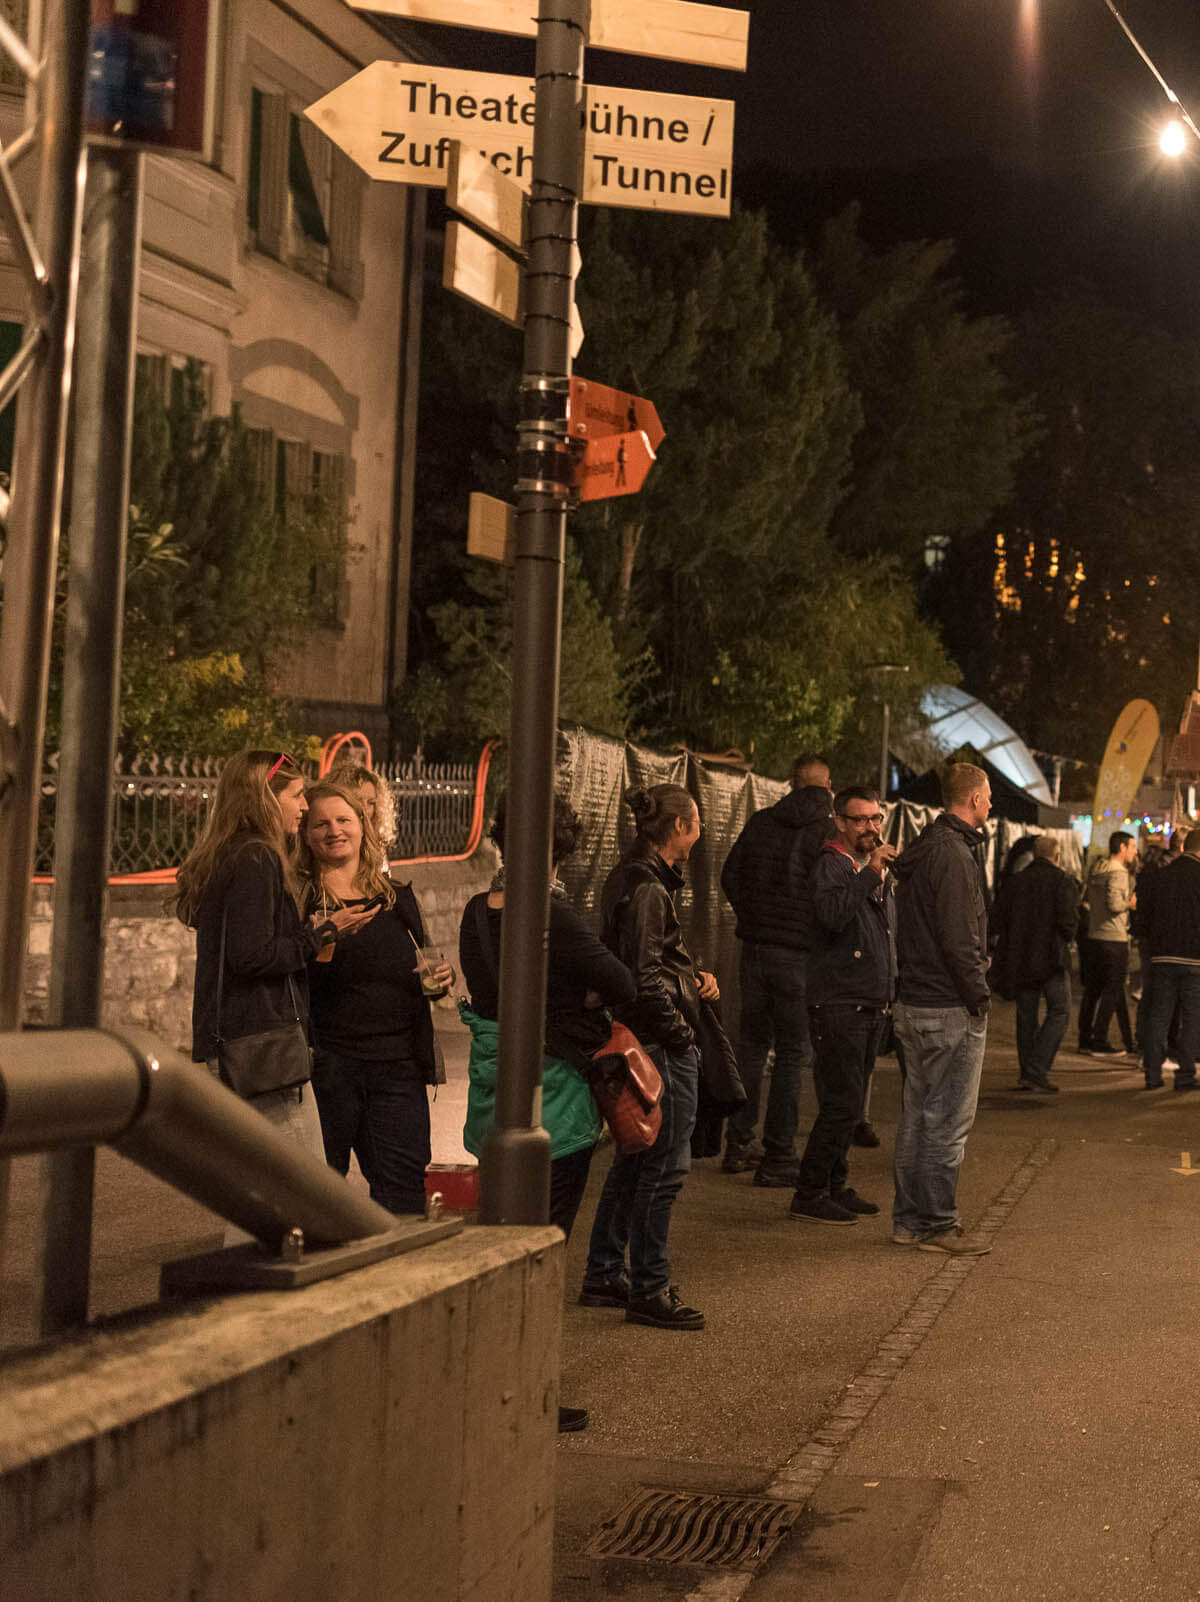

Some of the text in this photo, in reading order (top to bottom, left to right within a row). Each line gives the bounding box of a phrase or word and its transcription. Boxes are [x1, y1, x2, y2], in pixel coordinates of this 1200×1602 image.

[401, 80, 715, 146] Theateühne /
[593, 154, 728, 199] Tunnel
